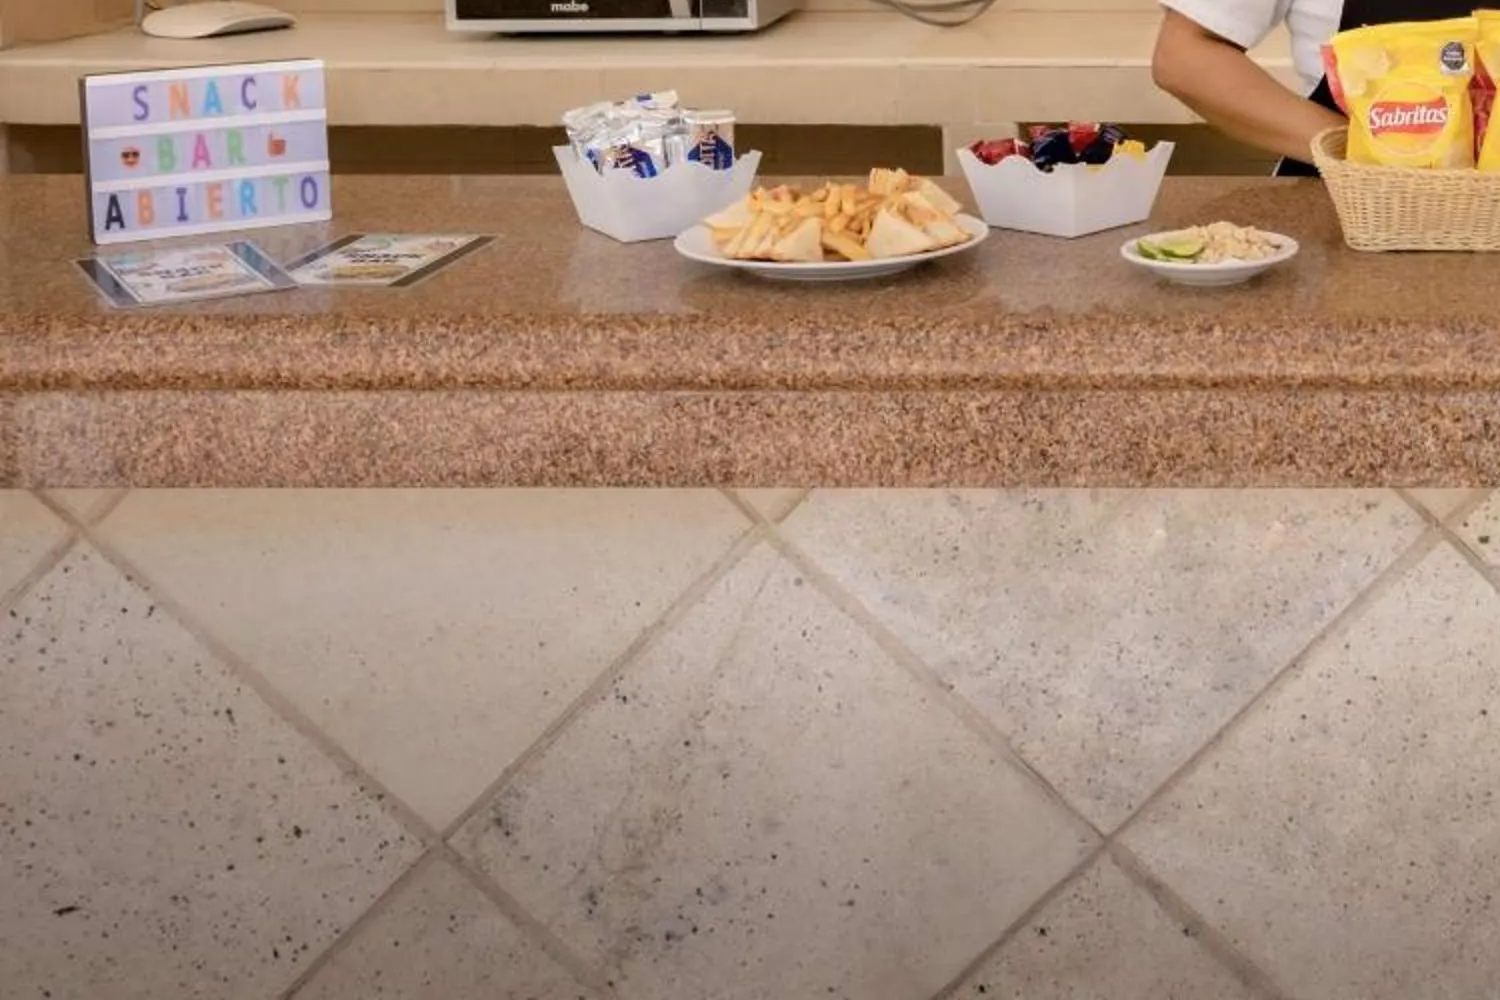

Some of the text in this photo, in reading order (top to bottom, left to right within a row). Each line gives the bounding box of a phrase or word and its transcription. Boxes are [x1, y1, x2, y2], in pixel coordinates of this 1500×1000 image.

[132, 73, 301, 122] SNACK
[1368, 103, 1449, 130] Sabritas
[156, 127, 247, 173] BAR
[104, 175, 319, 232] ABIERTO
